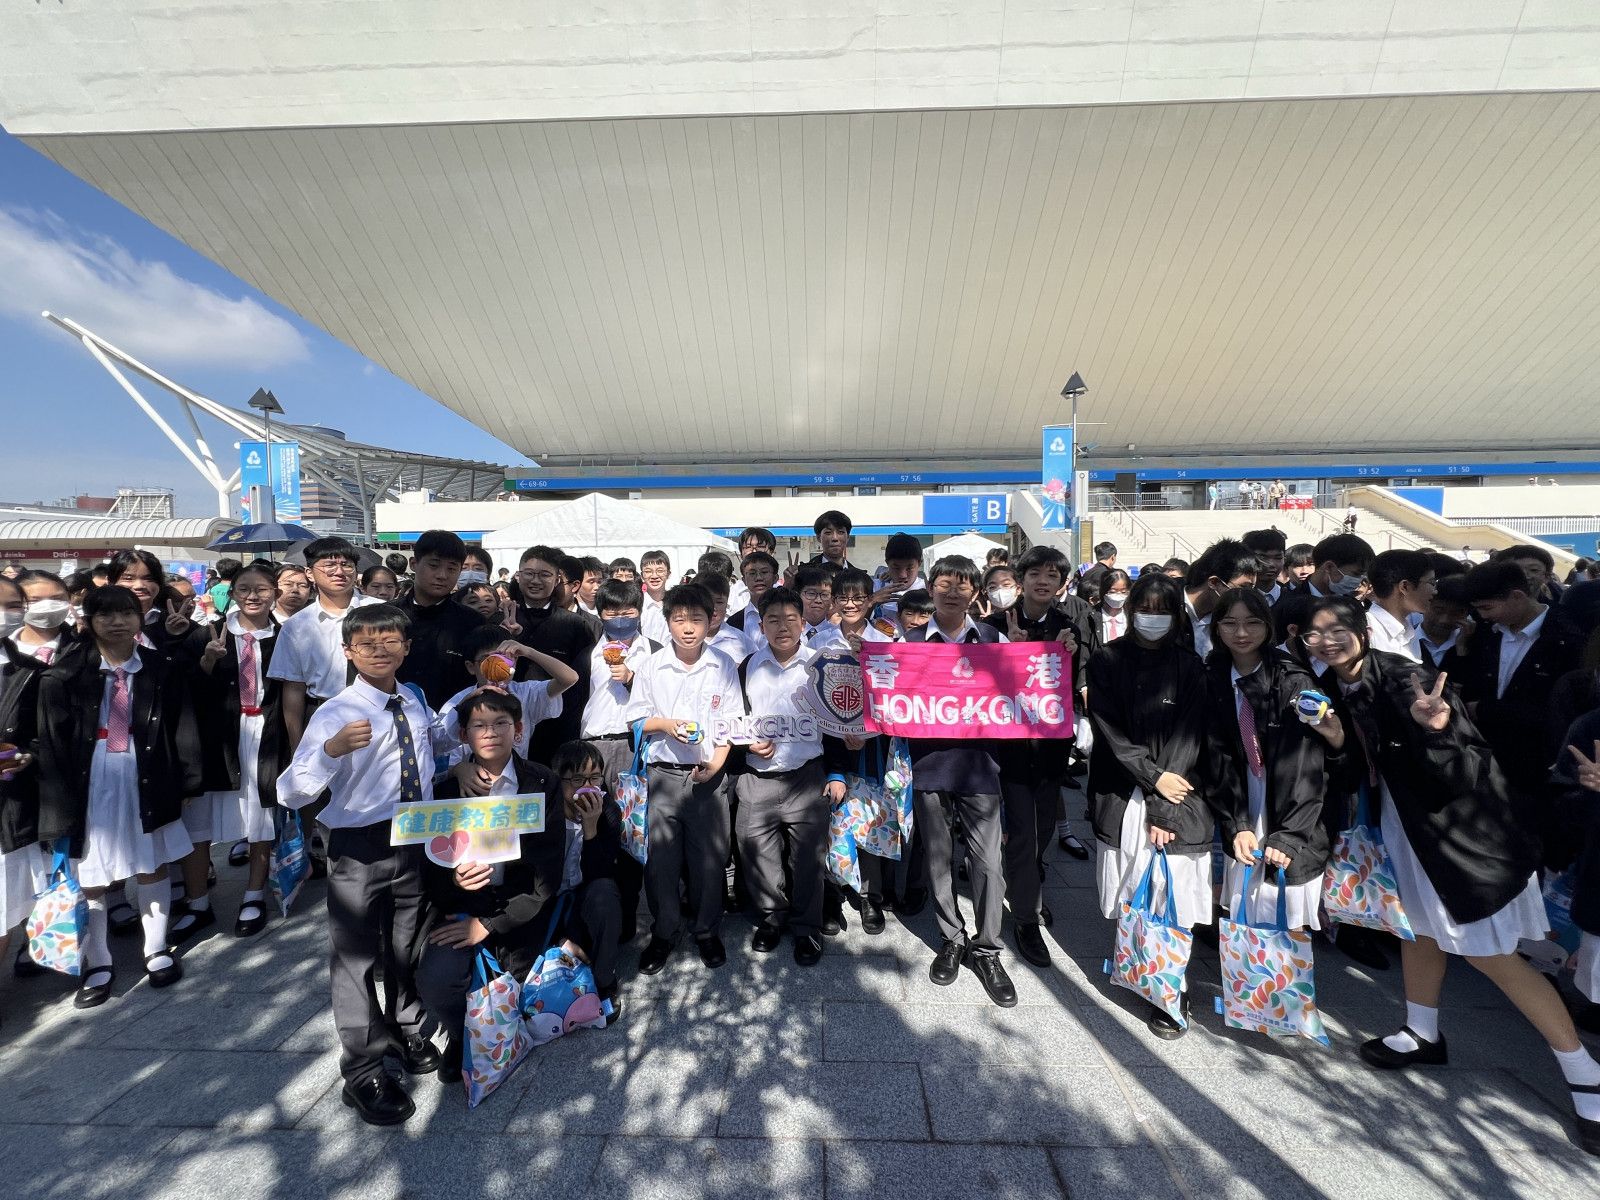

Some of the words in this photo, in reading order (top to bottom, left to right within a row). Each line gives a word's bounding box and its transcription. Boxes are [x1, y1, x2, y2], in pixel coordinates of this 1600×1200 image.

[971, 505, 979, 523] GATE
[987, 500, 1001, 520] B
[865, 654, 900, 690] 香
[1025, 653, 1062, 689] 港
[868, 693, 960, 725] HONG
[963, 692, 1064, 725] KONG
[817, 719, 837, 730] eline
[838, 725, 849, 733] Ho
